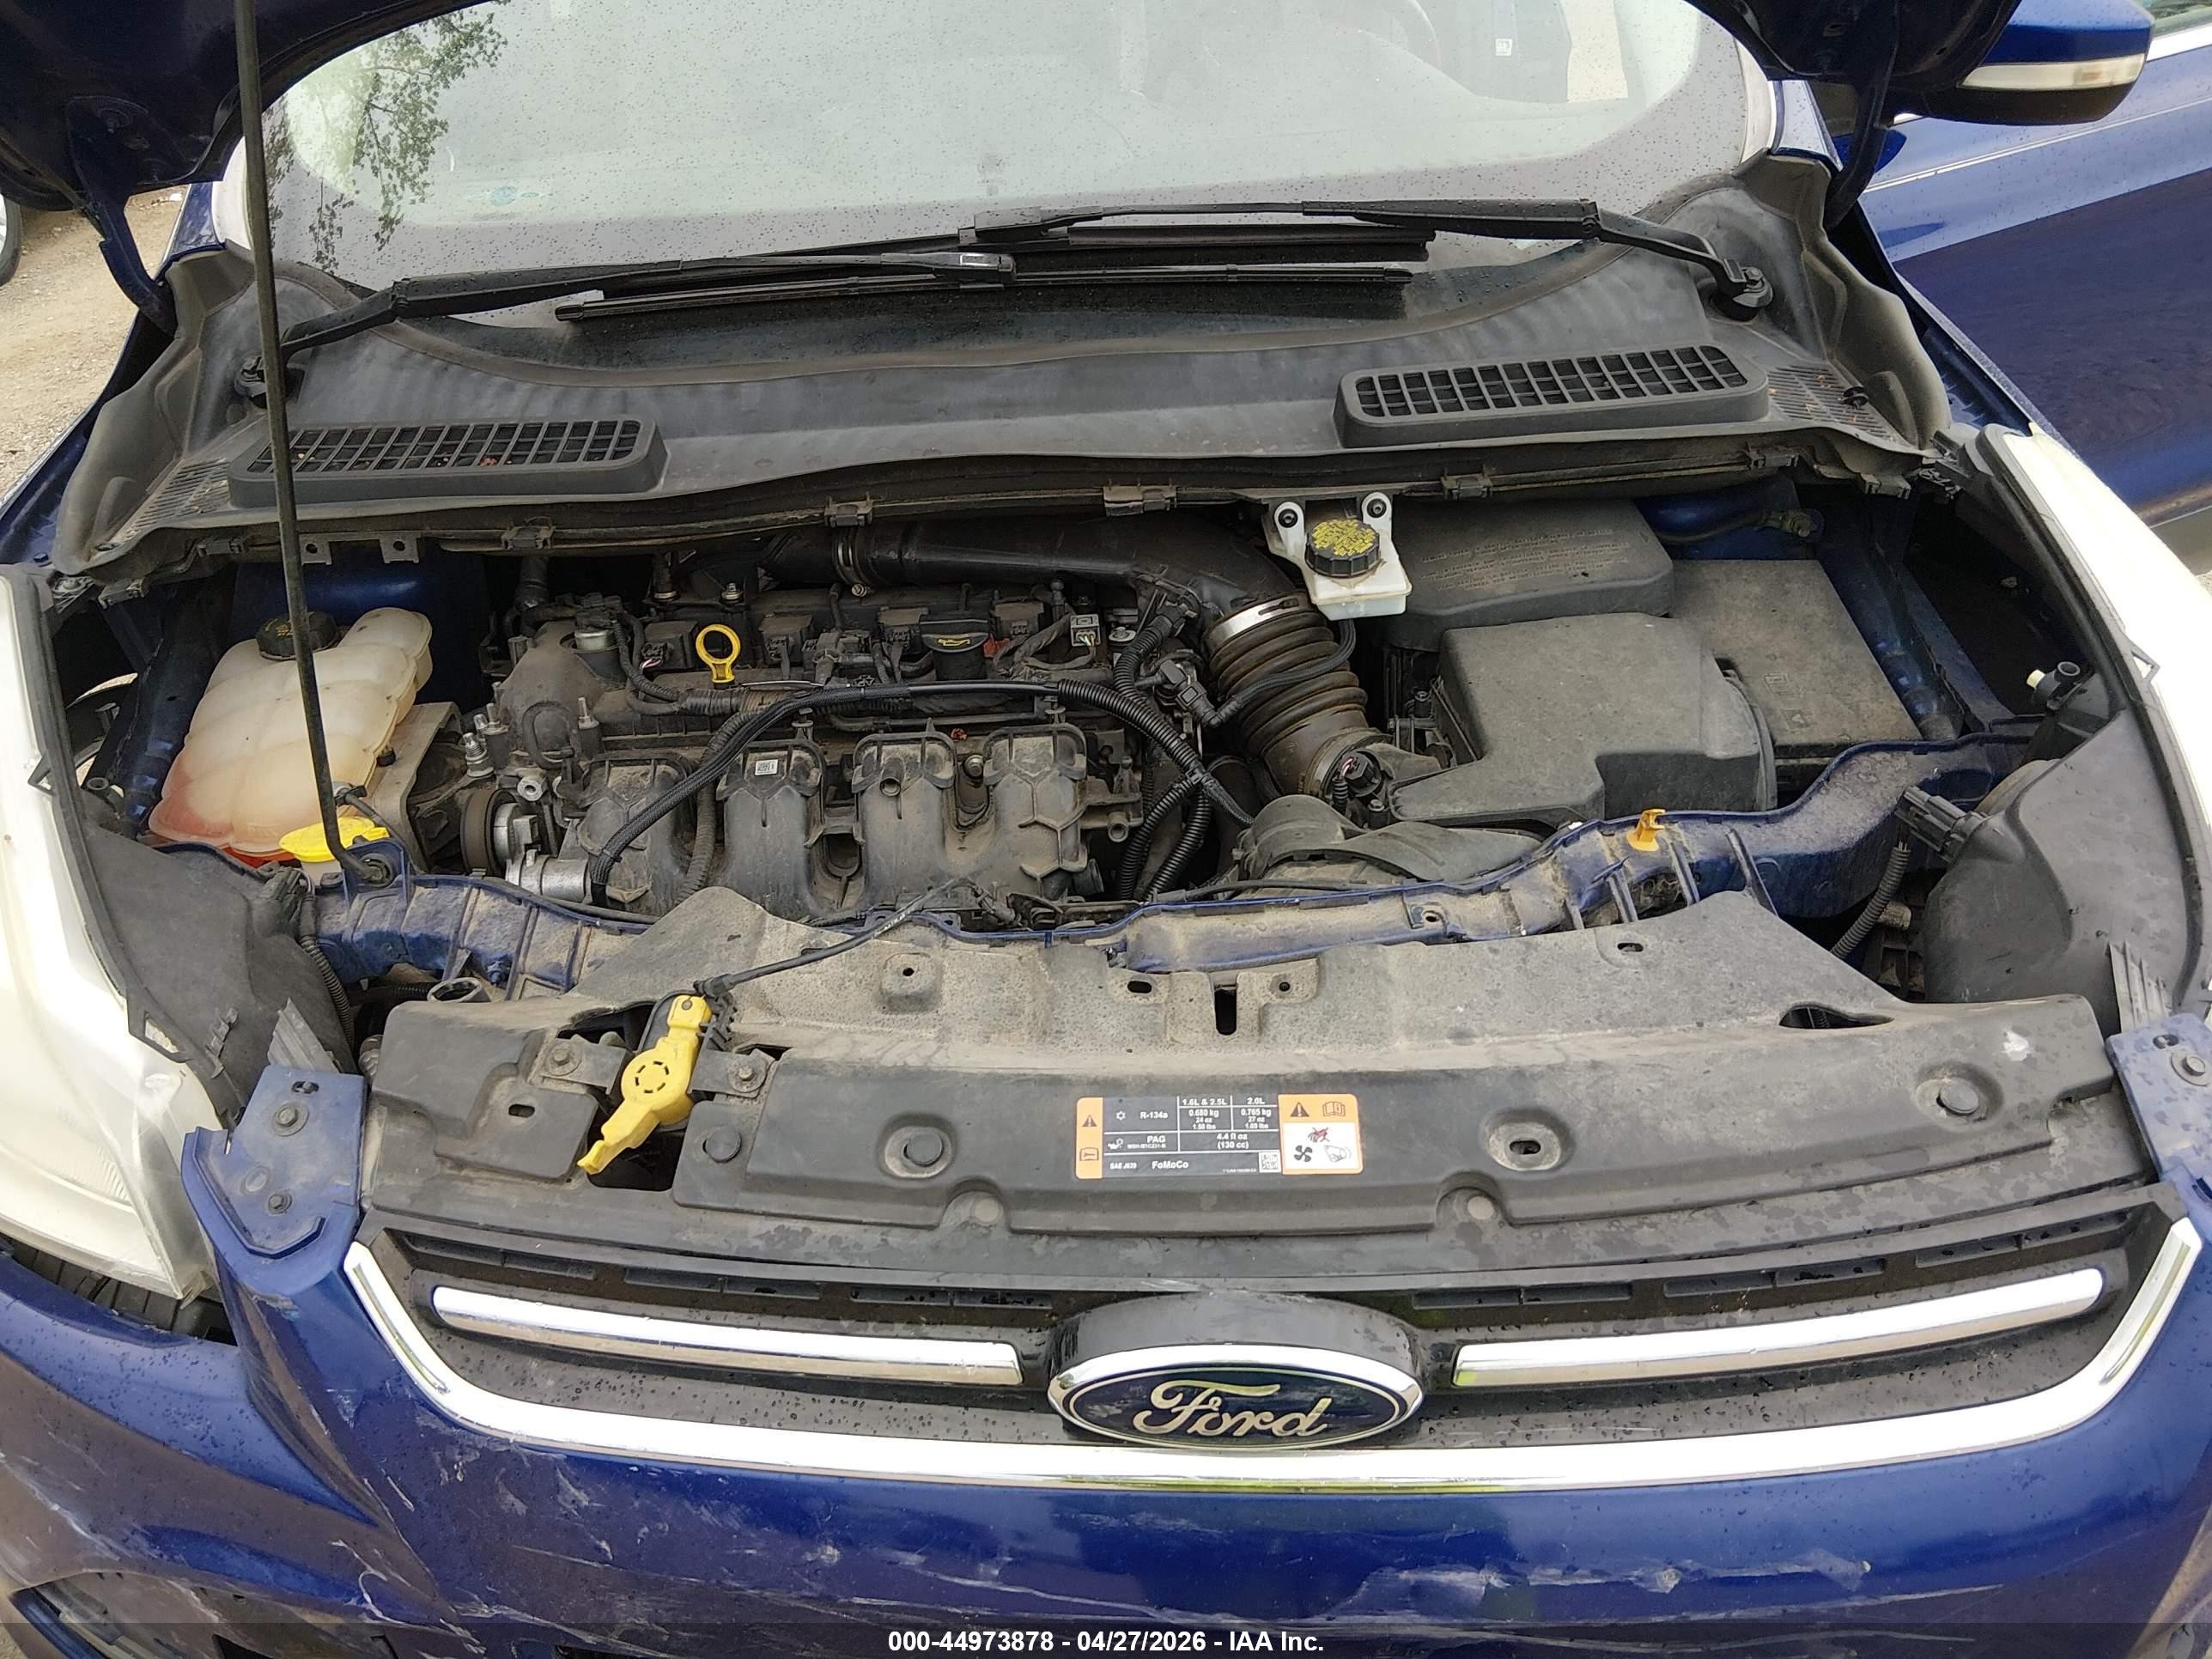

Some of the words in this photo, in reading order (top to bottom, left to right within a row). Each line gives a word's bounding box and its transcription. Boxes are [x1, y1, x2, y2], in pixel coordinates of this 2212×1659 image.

[1246, 1097, 1267, 1105] 2.0L
[1139, 1111, 1169, 1120] R-134a
[1209, 1109, 1219, 1118] kg
[1261, 1108, 1272, 1118] kg
[1146, 1135, 1166, 1144] PAG
[1217, 1140, 1235, 1151] (130
[1236, 1140, 1249, 1150] cc)
[1151, 1159, 1189, 1170] FoMoCo
[1132, 1379, 1332, 1437] Ford
